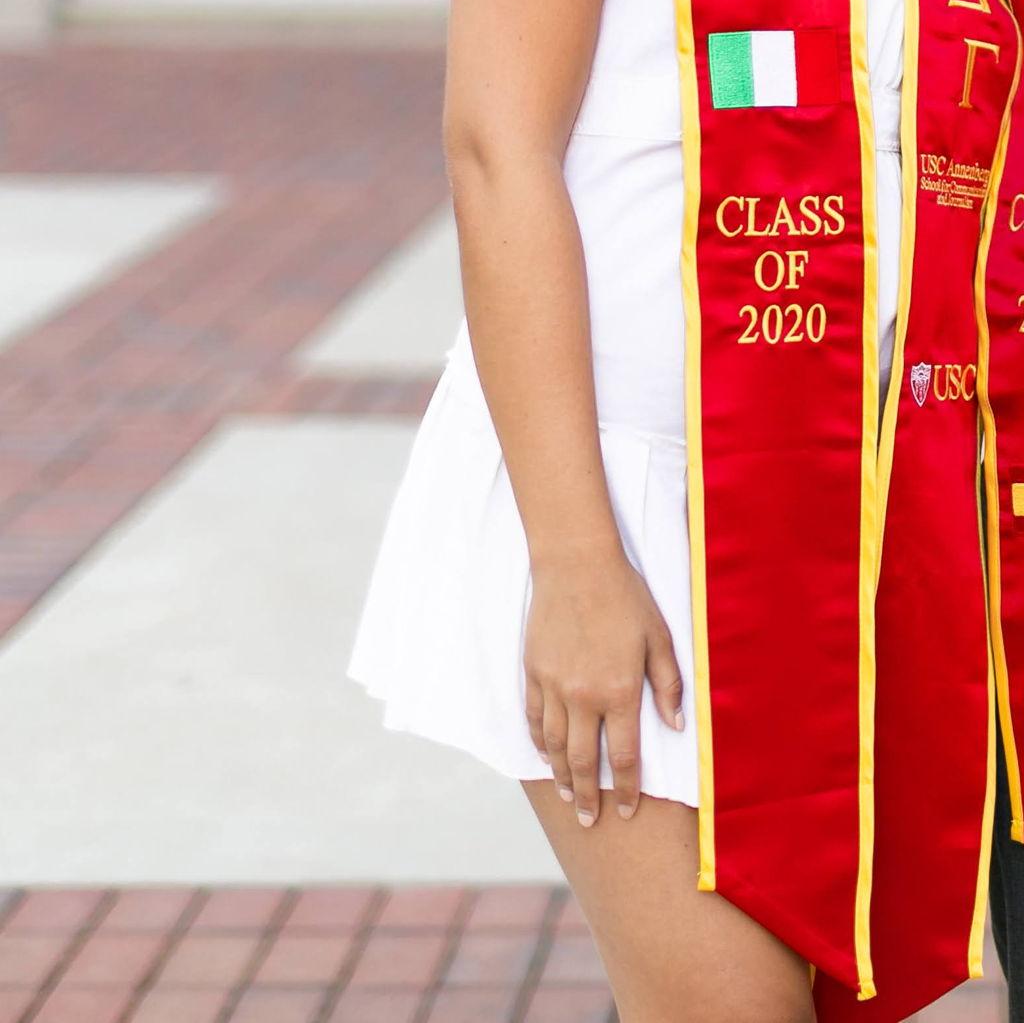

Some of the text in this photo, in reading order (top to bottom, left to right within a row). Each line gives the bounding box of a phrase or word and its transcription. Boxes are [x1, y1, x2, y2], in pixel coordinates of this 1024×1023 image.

[920, 154, 946, 176] USC
[716, 195, 845, 237] CLASS
[754, 250, 809, 292] OF
[737, 303, 827, 344] 2020
[933, 364, 976, 401] USC
